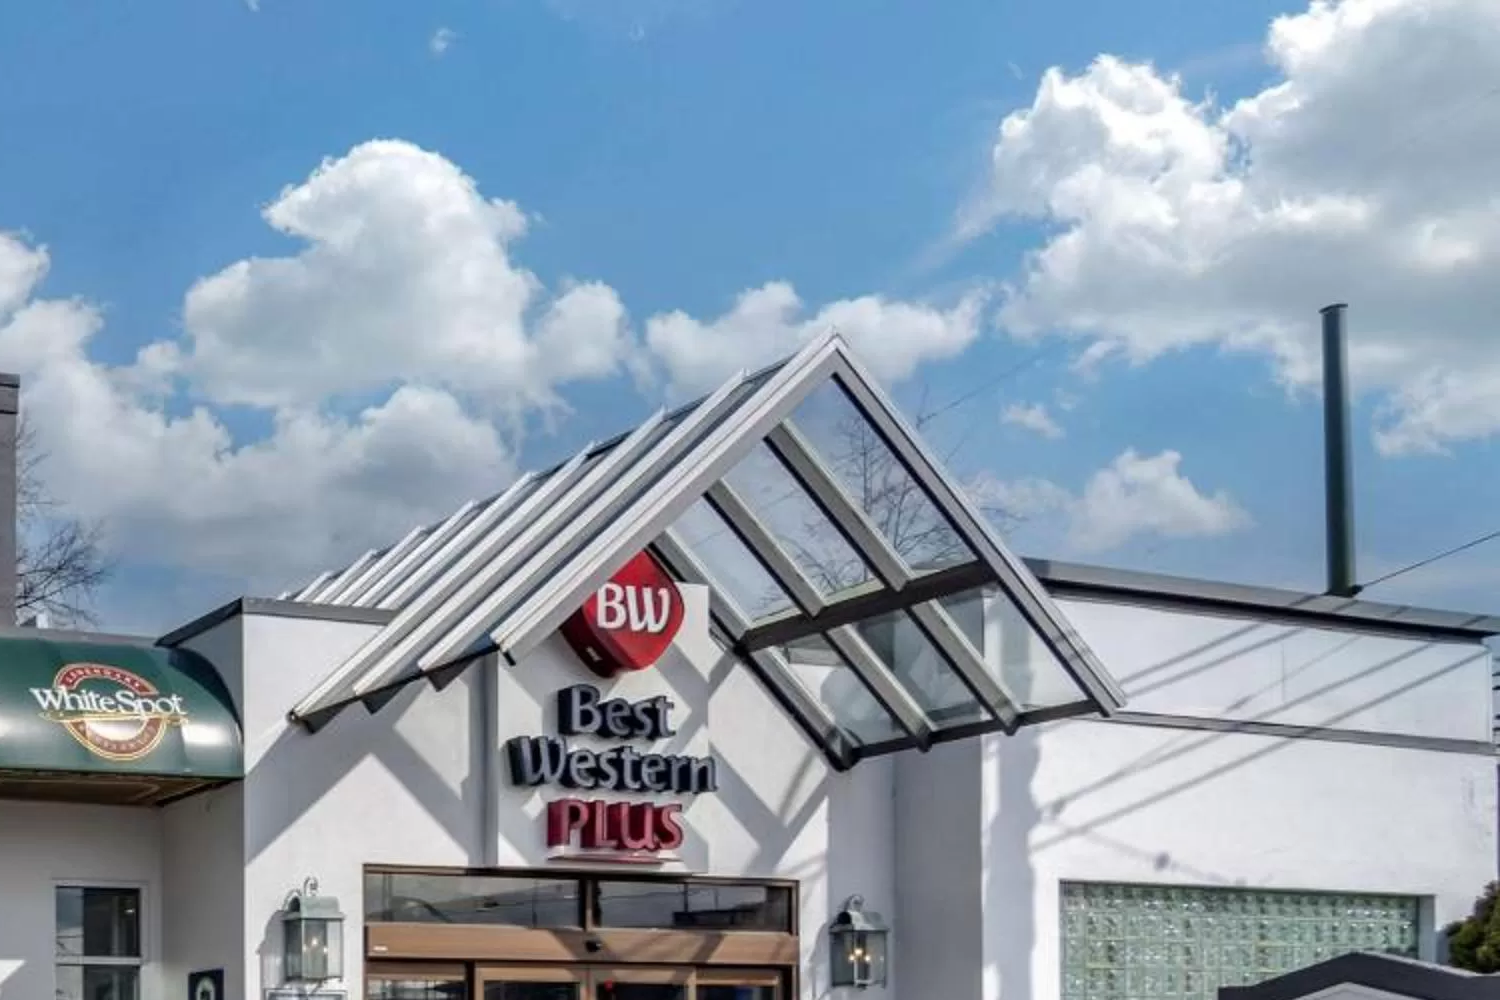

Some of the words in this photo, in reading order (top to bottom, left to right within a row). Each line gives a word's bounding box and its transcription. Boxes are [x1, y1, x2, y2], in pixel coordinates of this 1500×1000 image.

[597, 582, 670, 633] BW
[560, 684, 675, 737] Best
[508, 736, 719, 794] Western
[547, 799, 683, 851] PLUS
